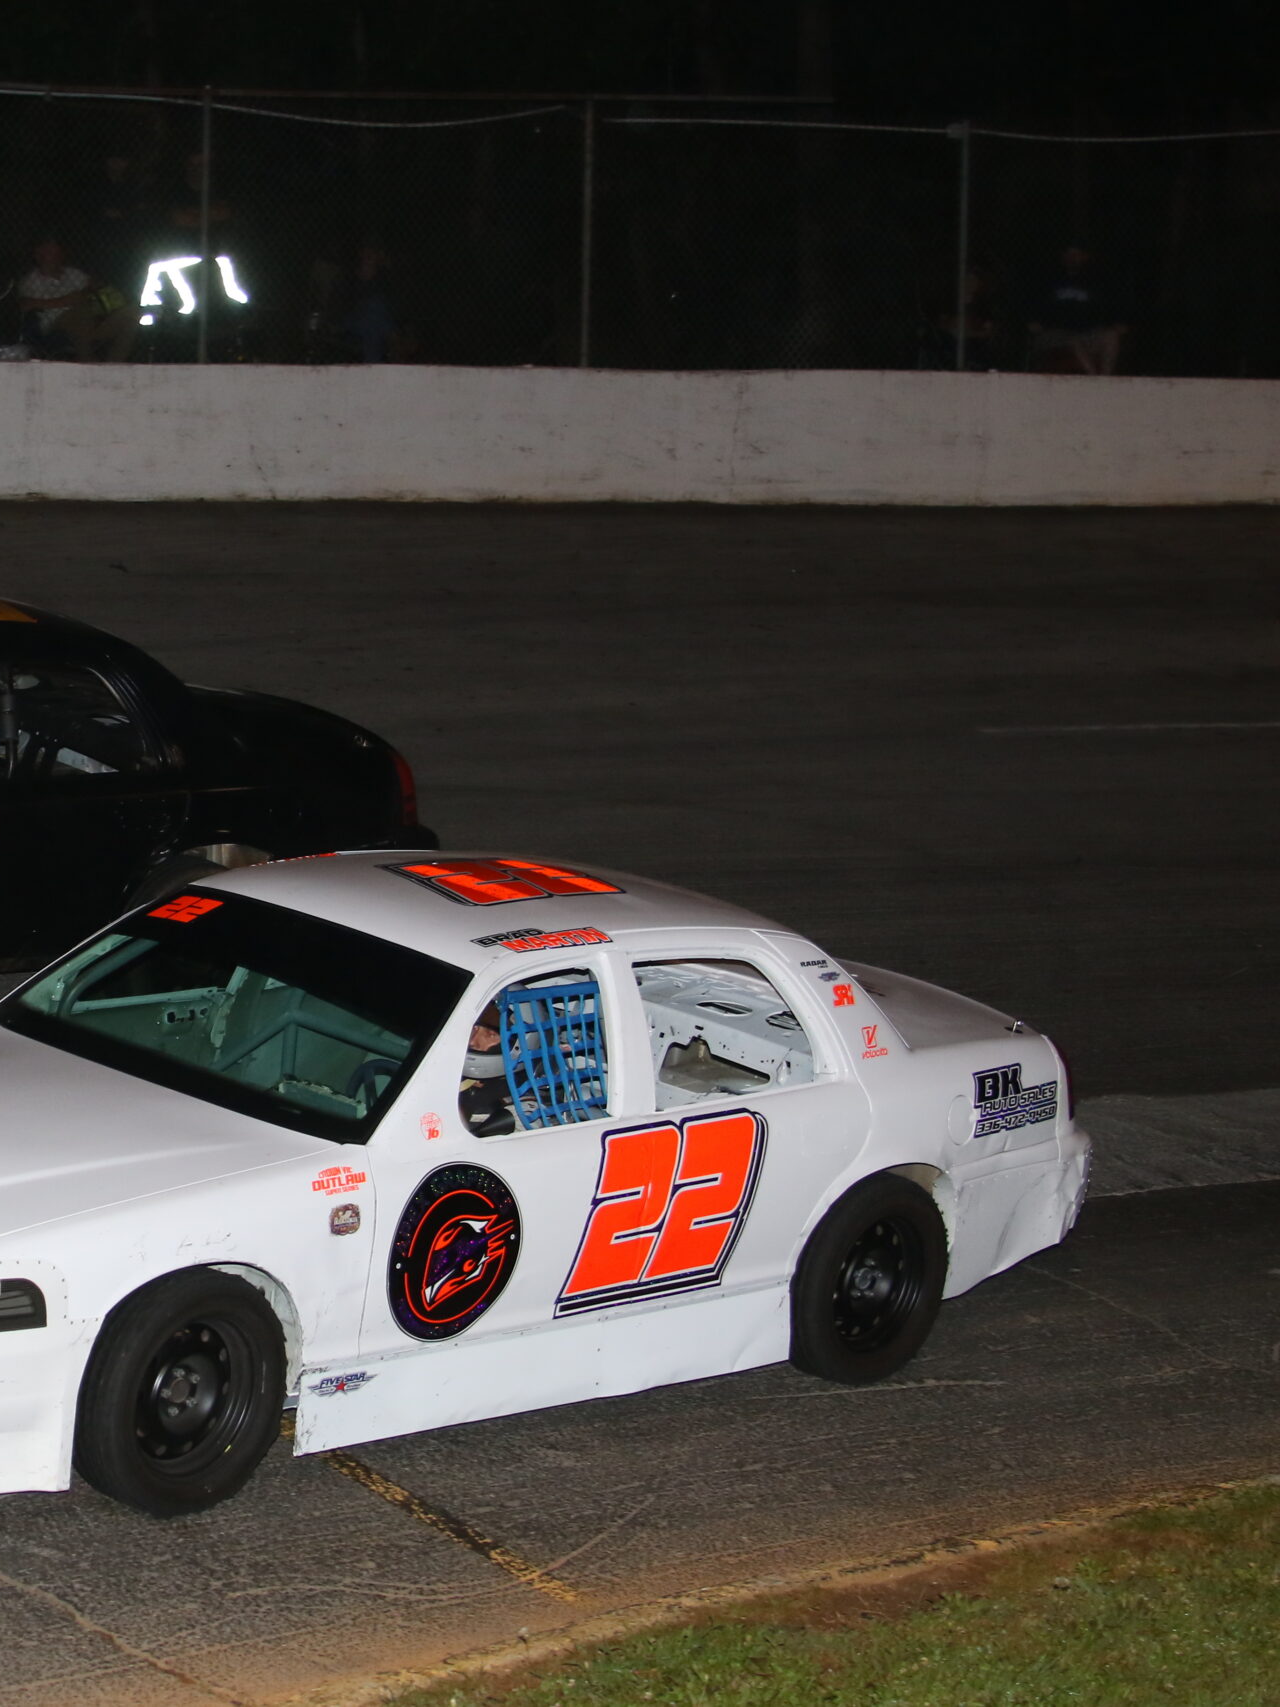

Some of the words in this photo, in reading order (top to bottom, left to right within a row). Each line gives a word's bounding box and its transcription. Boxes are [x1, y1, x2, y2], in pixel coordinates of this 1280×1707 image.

[388, 858, 624, 906] 22
[147, 895, 224, 923] 22
[472, 928, 544, 947] BRAD
[501, 927, 612, 952] MARTIN
[800, 959, 828, 968] RADAR
[976, 1066, 1022, 1104] BK
[982, 1096, 1019, 1115] AUTO
[1020, 1085, 1055, 1105] SALES
[312, 1171, 367, 1192] OUTLAW
[558, 1110, 761, 1302] 22
[320, 1377, 342, 1388] FIVE
[344, 1370, 367, 1382] STAR
